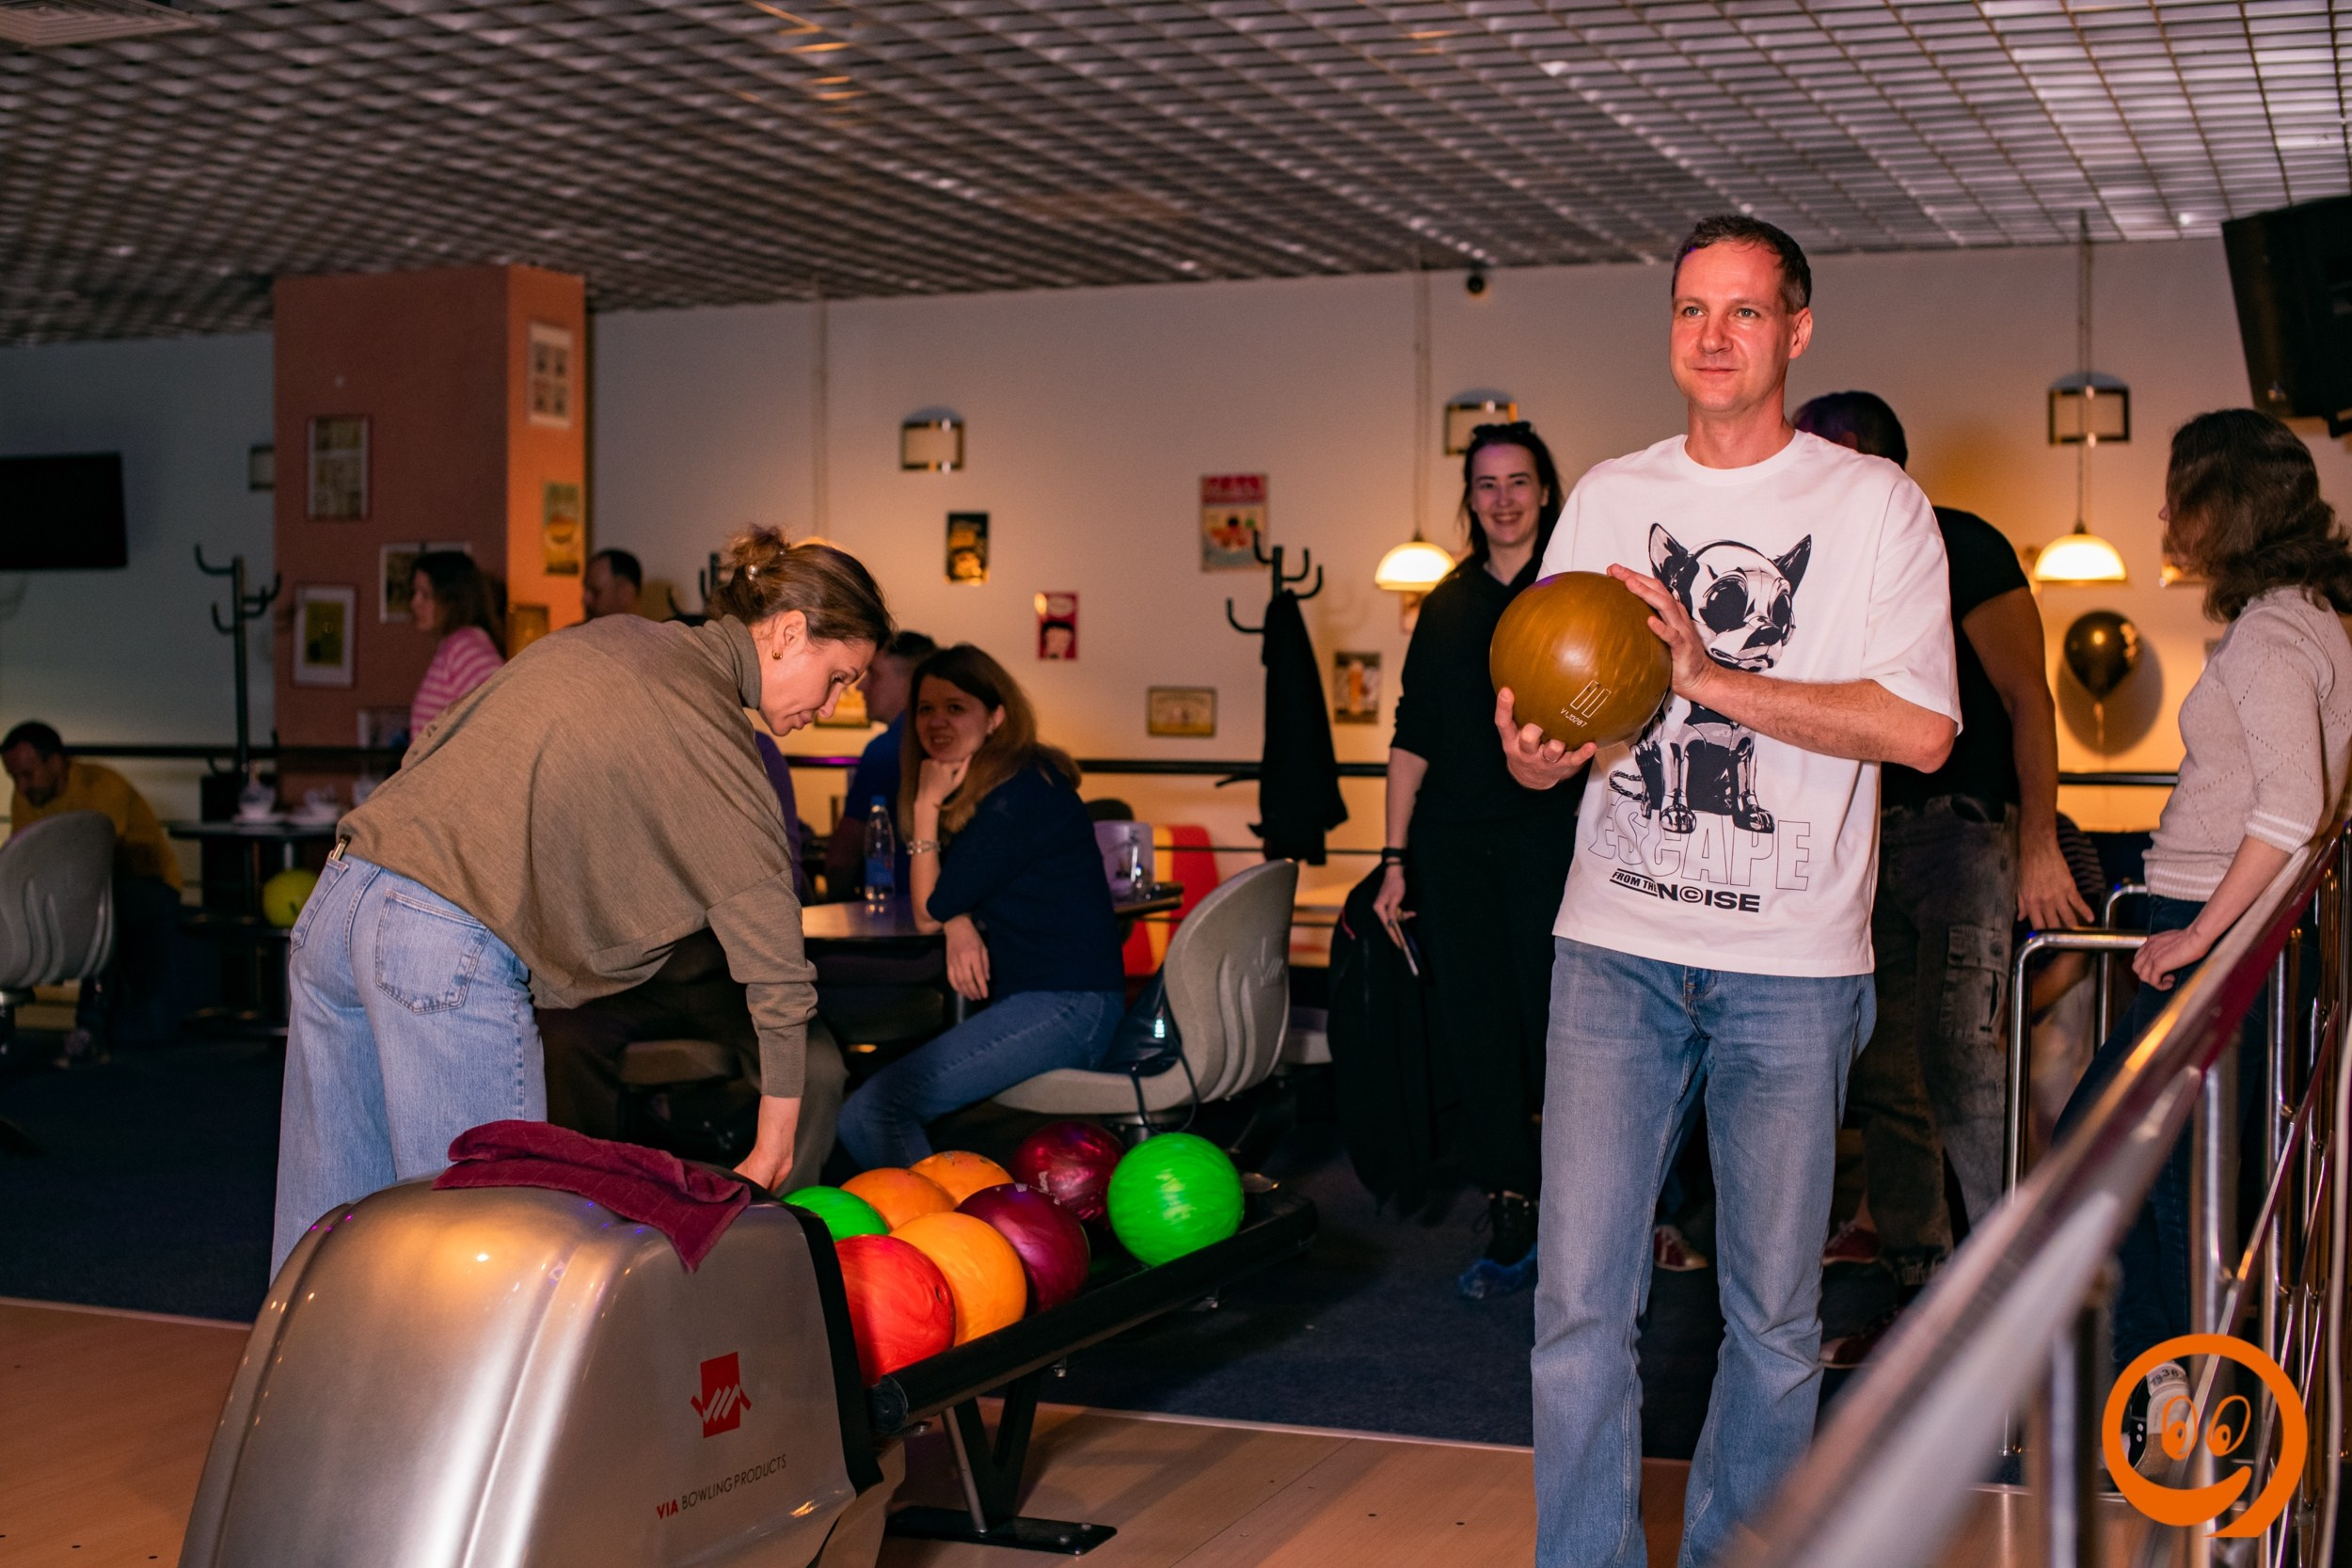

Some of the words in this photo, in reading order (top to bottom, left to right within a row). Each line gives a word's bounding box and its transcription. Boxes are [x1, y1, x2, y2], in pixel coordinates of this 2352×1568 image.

[1588, 794, 1811, 892] ESCAPE
[1612, 871, 1642, 887] FROM
[1643, 879, 1658, 893] THE
[656, 1499, 679, 1520] VIA
[681, 1477, 733, 1511] BOWLING
[734, 1454, 787, 1489] PRODUCTS
